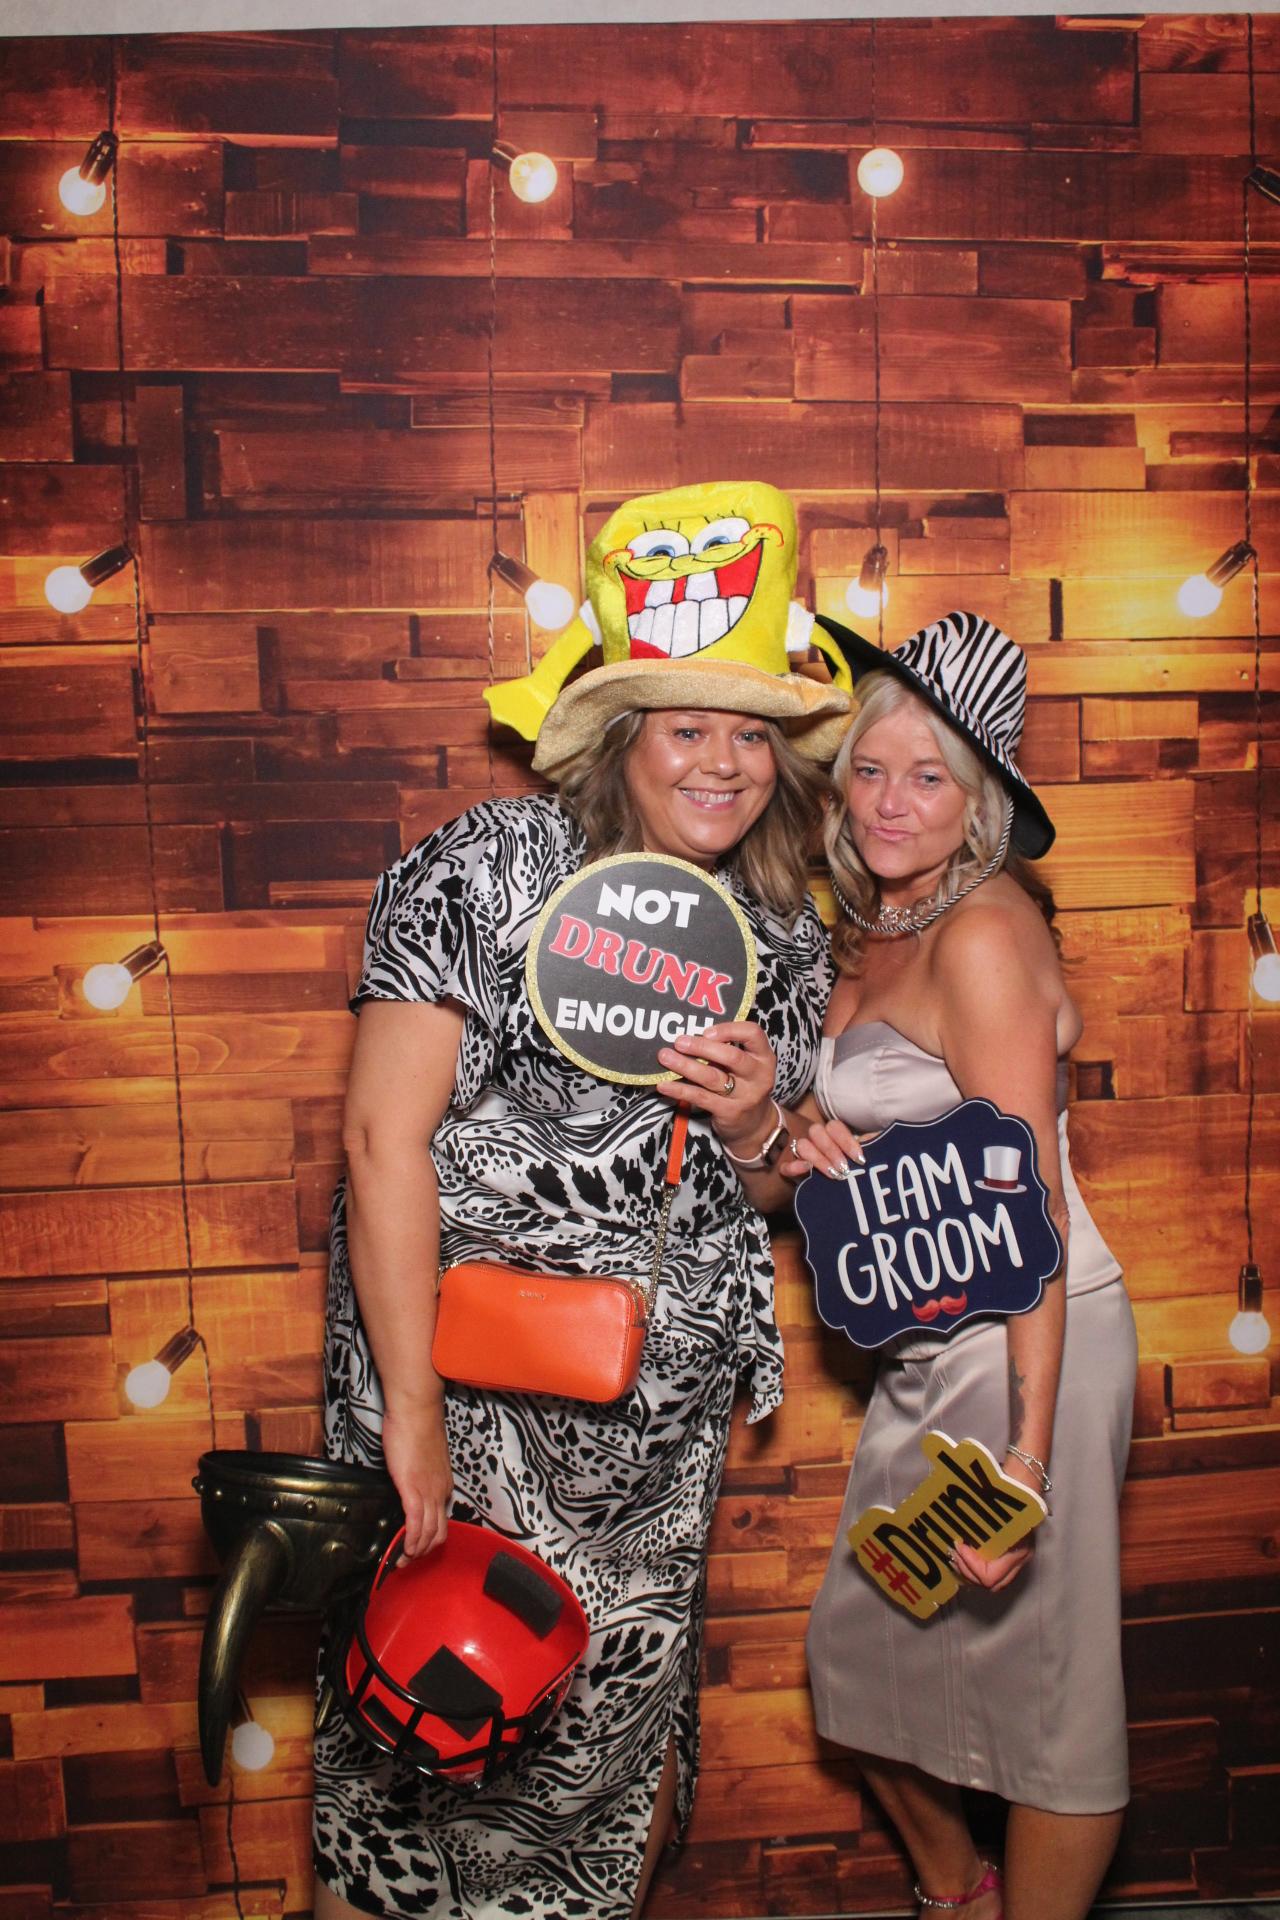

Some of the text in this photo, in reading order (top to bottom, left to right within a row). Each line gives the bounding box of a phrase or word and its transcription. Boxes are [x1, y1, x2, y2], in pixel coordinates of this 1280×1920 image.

[597, 882, 700, 928] NOT
[549, 914, 733, 1015] DRUNK
[847, 1142, 973, 1236] TEAM
[837, 1203, 1023, 1311] GROOM
